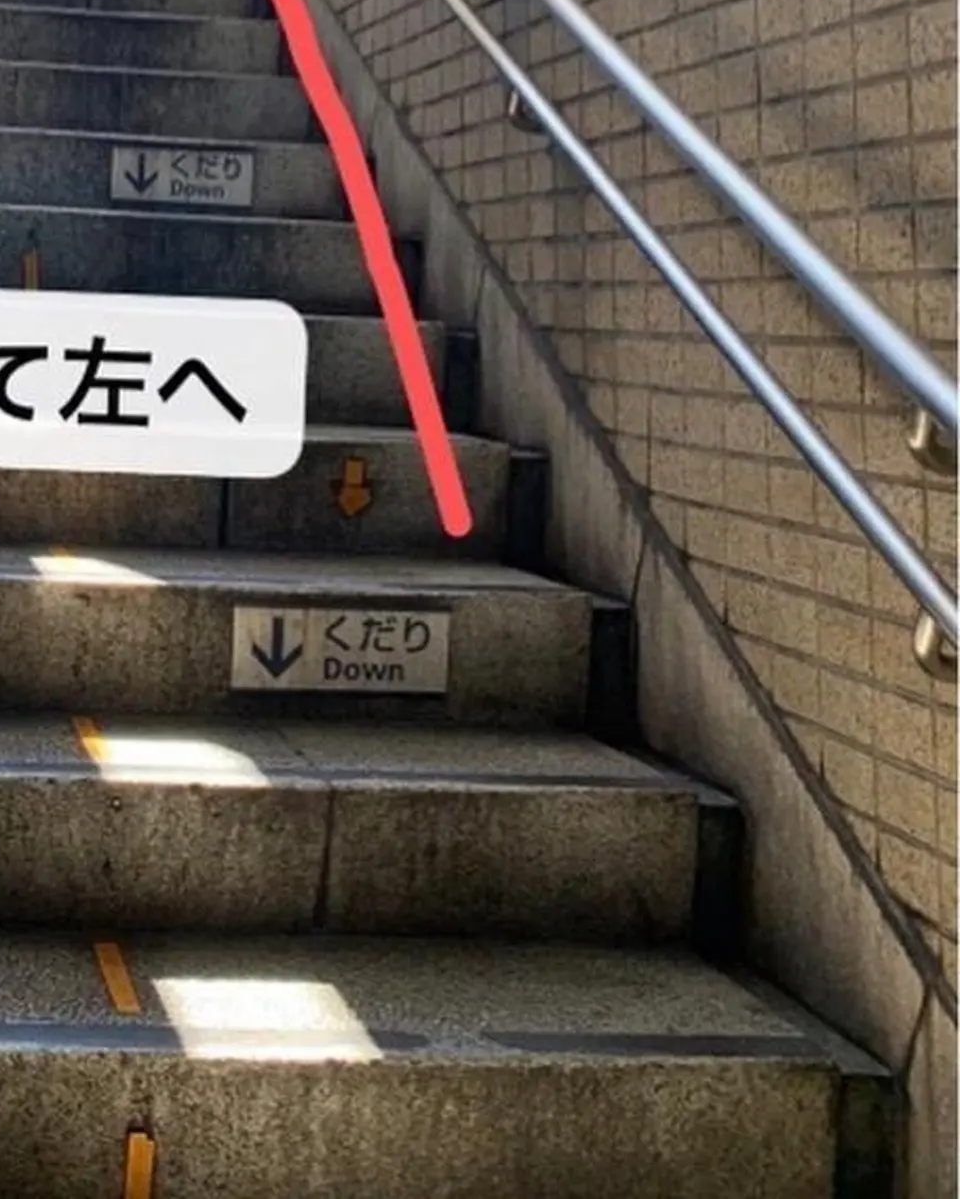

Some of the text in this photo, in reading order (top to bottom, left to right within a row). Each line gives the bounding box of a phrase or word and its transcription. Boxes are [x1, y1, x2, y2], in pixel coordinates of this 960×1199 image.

[171, 153, 242, 181] くだり
[170, 179, 225, 199] Down
[324, 615, 431, 654] くだり
[323, 657, 405, 682] Down
